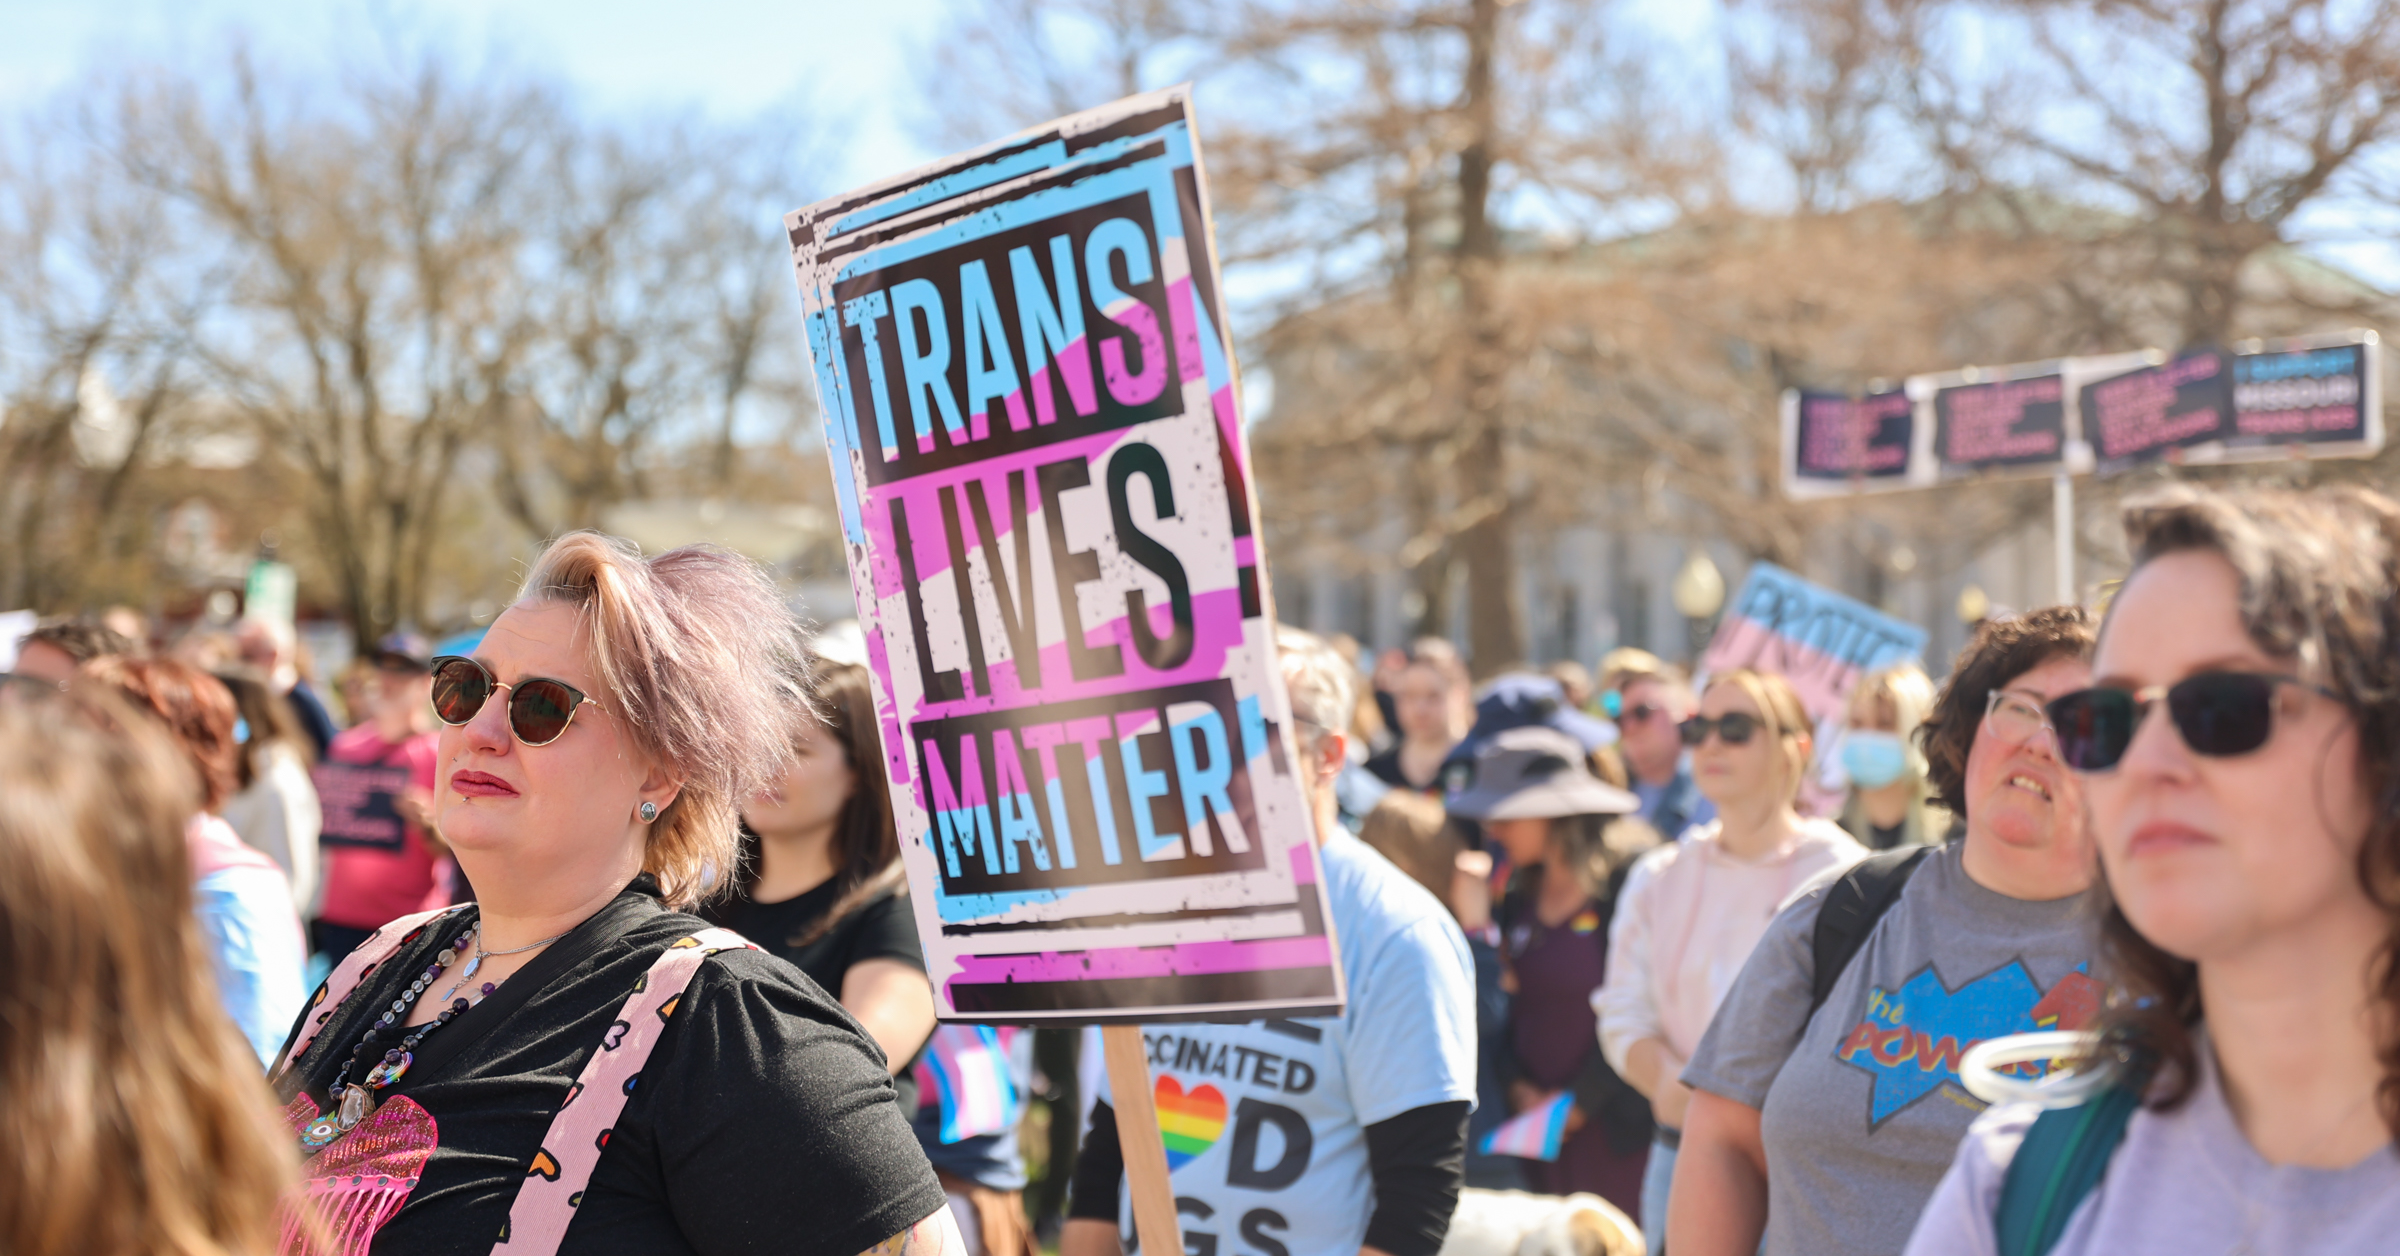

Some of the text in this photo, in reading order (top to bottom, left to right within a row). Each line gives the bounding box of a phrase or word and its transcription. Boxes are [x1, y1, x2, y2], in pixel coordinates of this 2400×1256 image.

[844, 217, 1169, 463] TRANS
[888, 442, 1195, 705] LIVES
[1723, 577, 1918, 690] PROTEC
[922, 700, 1251, 878] MATTER
